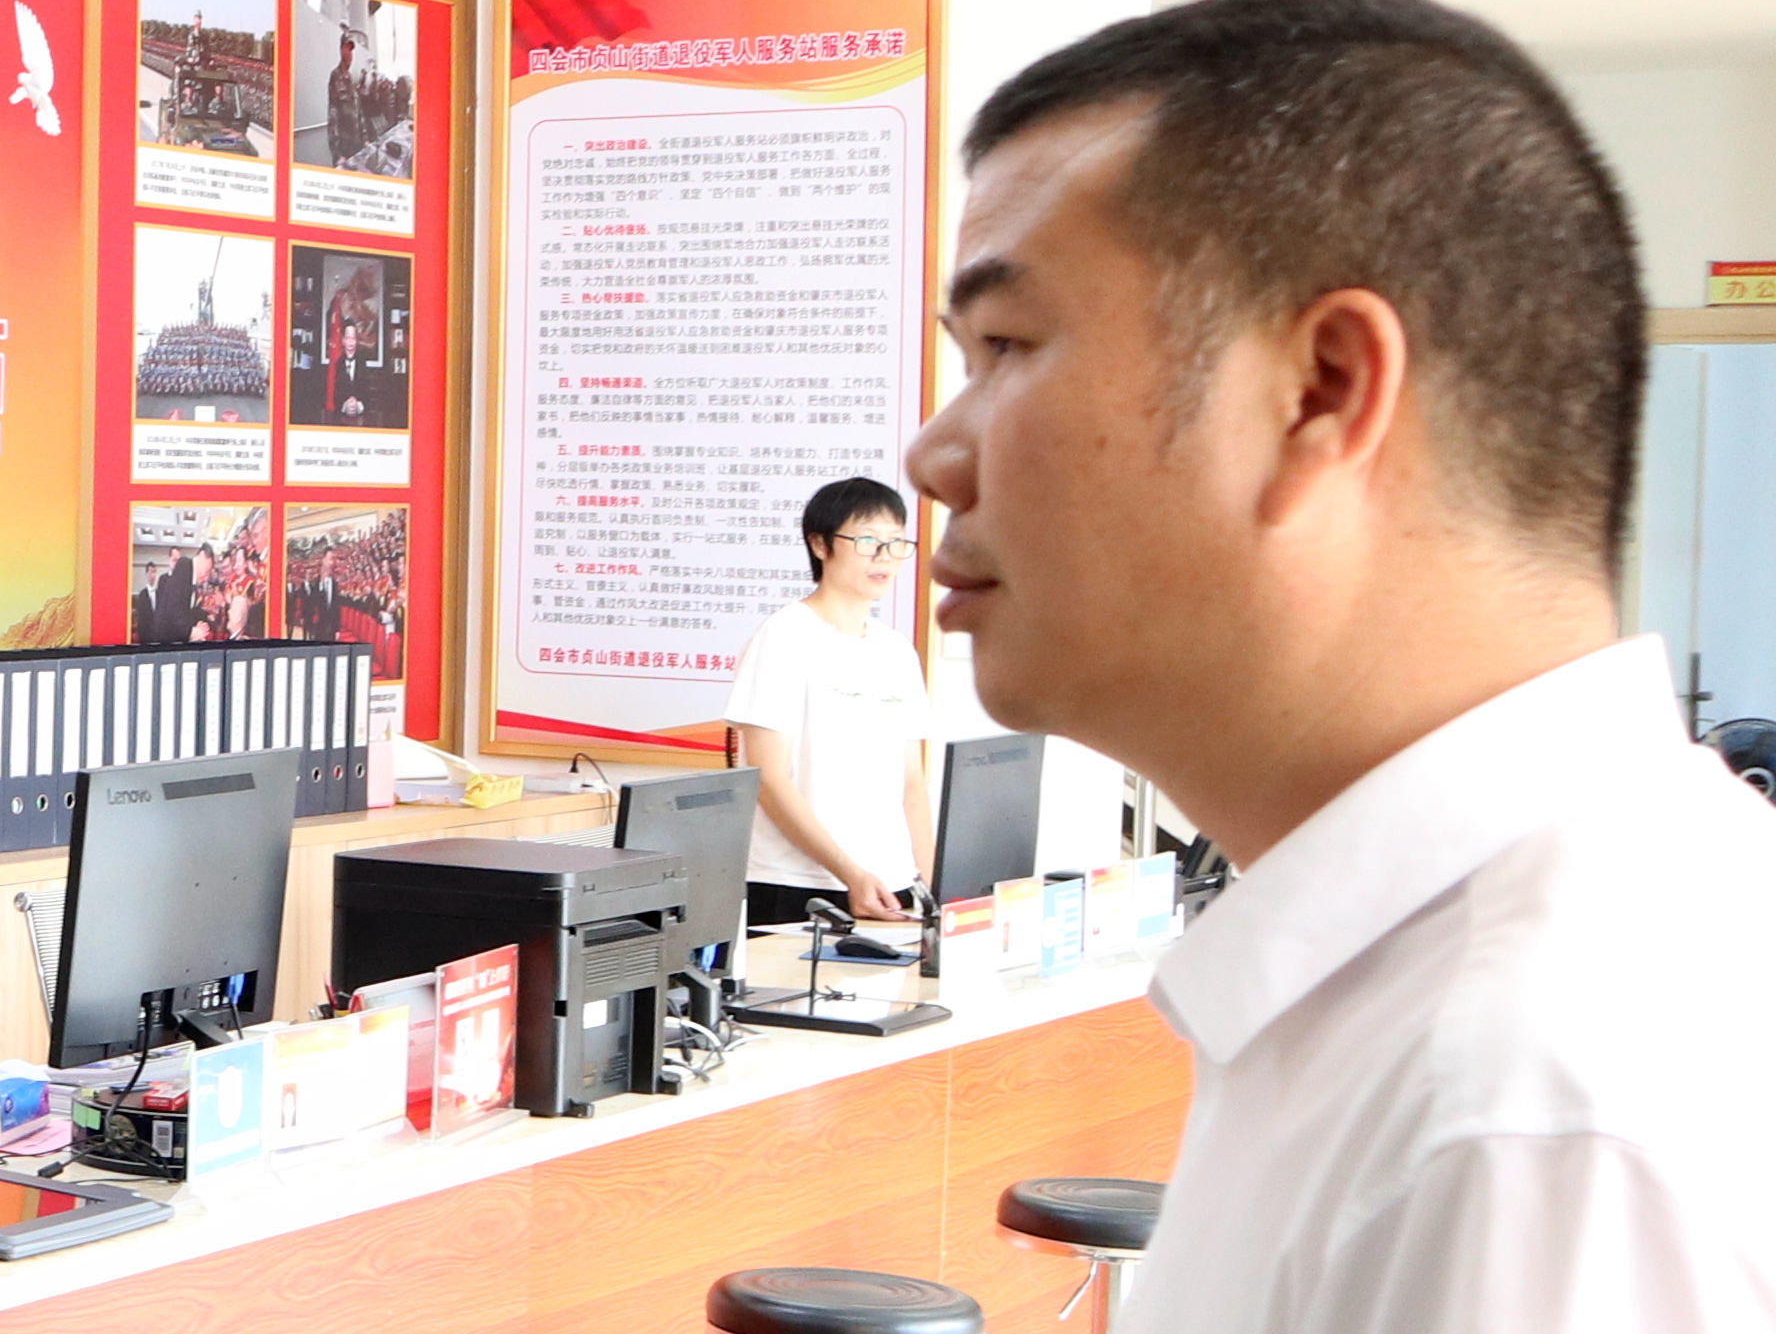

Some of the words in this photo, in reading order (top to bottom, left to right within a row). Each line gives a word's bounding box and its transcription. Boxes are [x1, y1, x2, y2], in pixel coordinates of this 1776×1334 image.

[529, 30, 907, 73] 四会市贞山街道退役军人服务站服务承诺
[539, 647, 736, 672] 四会市贞山街道退役军人服务站
